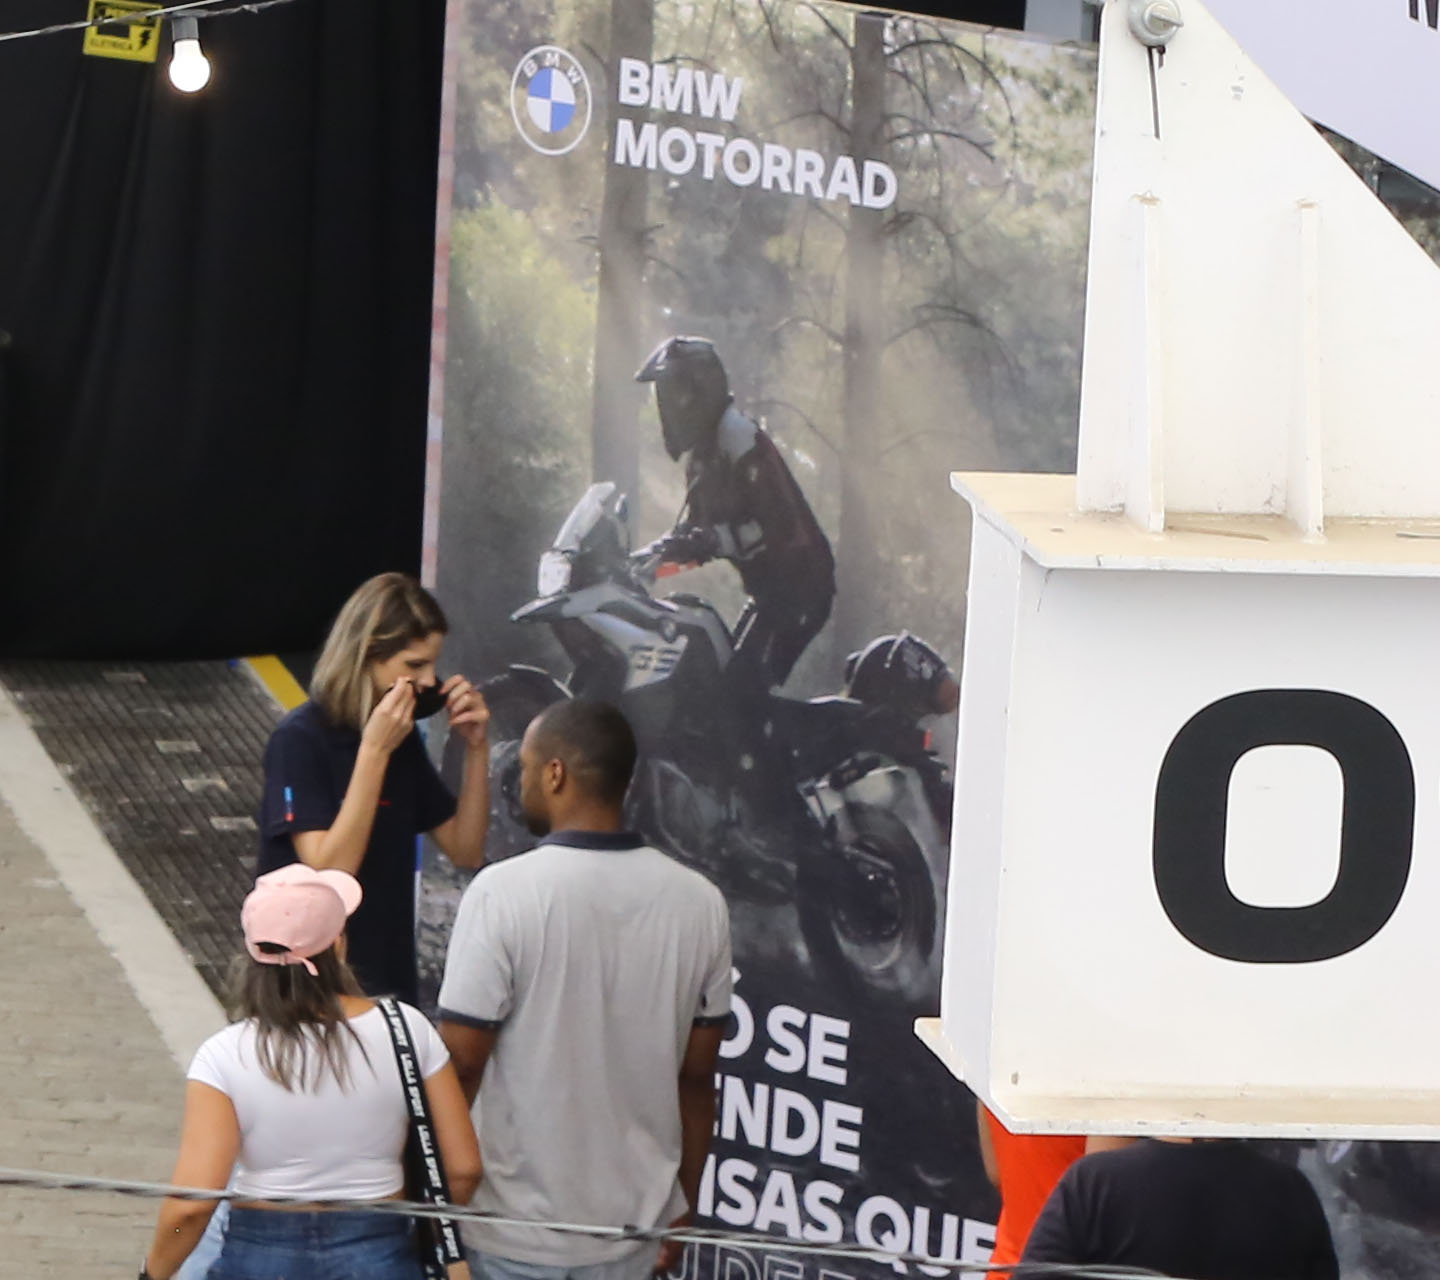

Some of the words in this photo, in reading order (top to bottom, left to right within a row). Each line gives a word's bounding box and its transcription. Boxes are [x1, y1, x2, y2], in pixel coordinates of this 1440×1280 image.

[522, 51, 583, 87] BMW
[619, 57, 744, 121] BMW
[614, 119, 898, 210] MOTORRAD
[765, 1003, 851, 1086] SE
[713, 1072, 864, 1173] NDE
